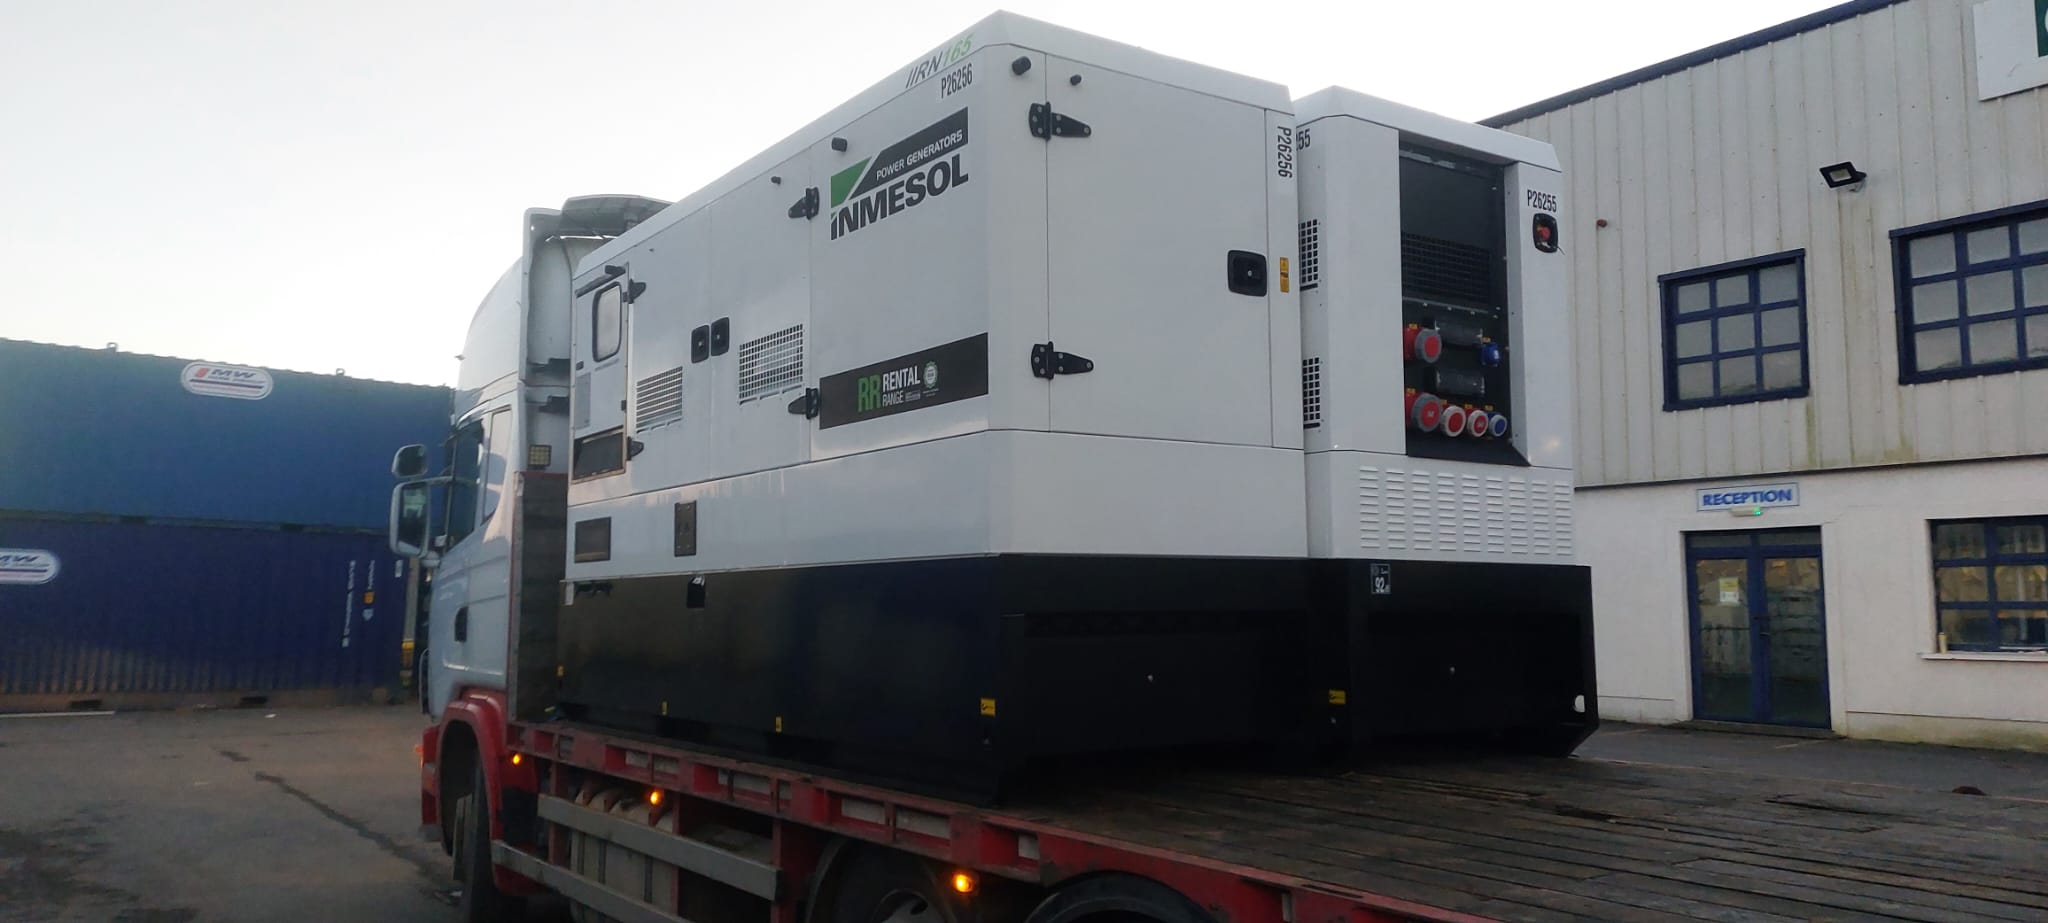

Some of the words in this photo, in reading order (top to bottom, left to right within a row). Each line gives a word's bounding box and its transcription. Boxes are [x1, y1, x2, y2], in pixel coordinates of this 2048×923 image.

[941, 62, 973, 99] P26256
[1277, 126, 1293, 178] P26256
[1296, 128, 1311, 151] 55
[875, 158, 904, 181] POWER
[906, 129, 963, 165] GENERATORS
[1527, 189, 1557, 213] P26255
[882, 365, 921, 392] RENTAL
[857, 374, 880, 413] RR
[882, 390, 905, 407] RANGE
[1703, 488, 1792, 506] RECEPTION
